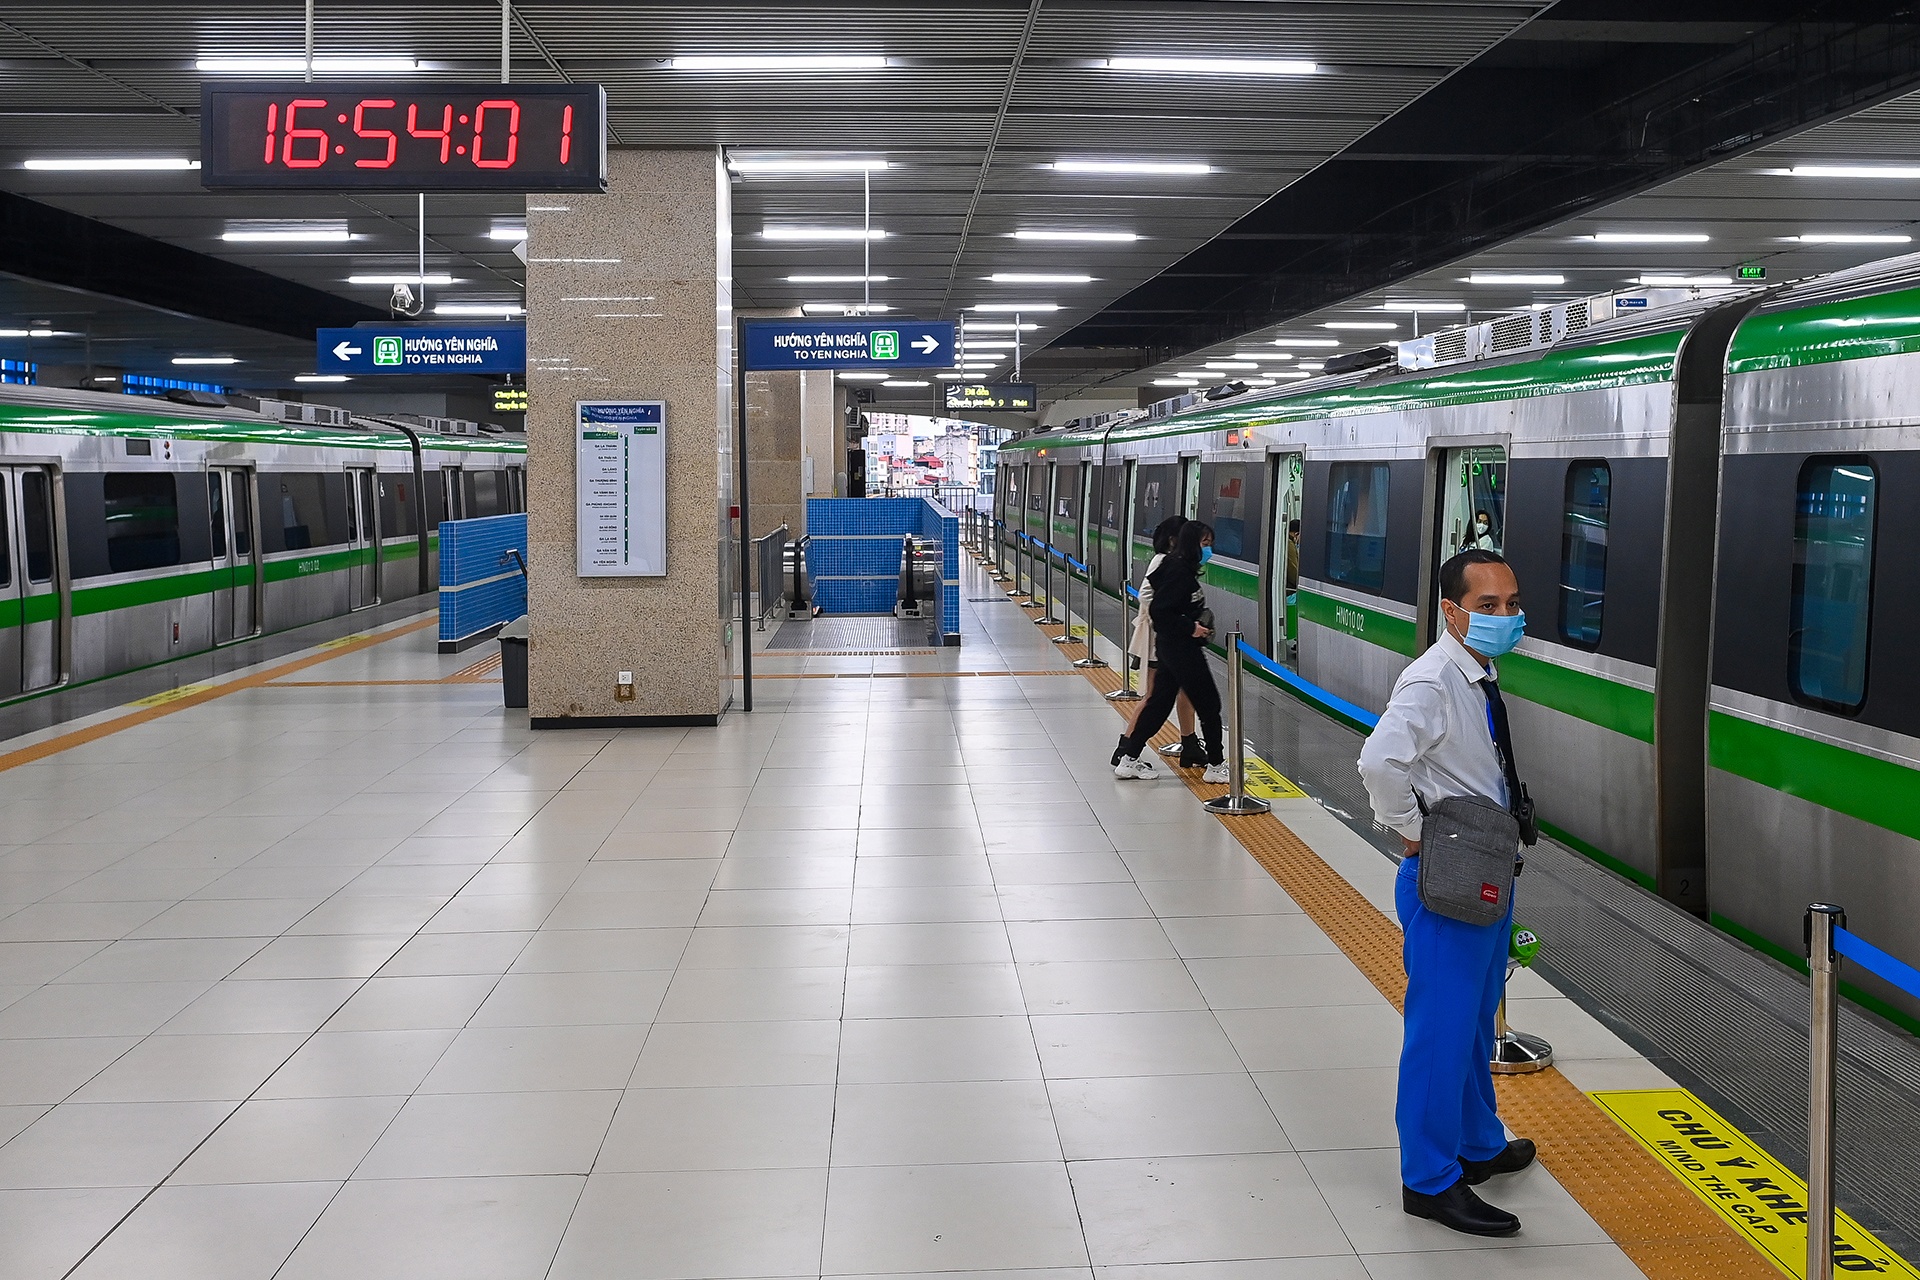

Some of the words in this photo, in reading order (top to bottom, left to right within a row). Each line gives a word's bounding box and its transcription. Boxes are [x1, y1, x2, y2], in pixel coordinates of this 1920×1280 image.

[405, 336, 442, 351] HƯỚNG
[444, 336, 464, 351] YÊN
[466, 336, 498, 351] NGHĨA
[774, 332, 812, 347] HƯỚNG
[813, 332, 833, 347] YÊN
[836, 332, 867, 347] NGHĨA
[405, 354, 421, 364] TO
[422, 354, 445, 364] YEN
[447, 354, 483, 364] NGHIA
[794, 350, 809, 359] TO
[810, 350, 832, 359] YEN
[834, 350, 868, 359] NGHIA
[998, 399, 1004, 407] 9
[1336, 605, 1356, 629] HN010
[1356, 612, 1364, 632] 02
[1680, 879, 1689, 896] 2
[1657, 1109, 1734, 1150] CHÚ
[1716, 1156, 1760, 1170] Ý
[1656, 1140, 1706, 1173] MIND
[1699, 1174, 1736, 1201] THE
[1731, 1204, 1779, 1234] GAP
